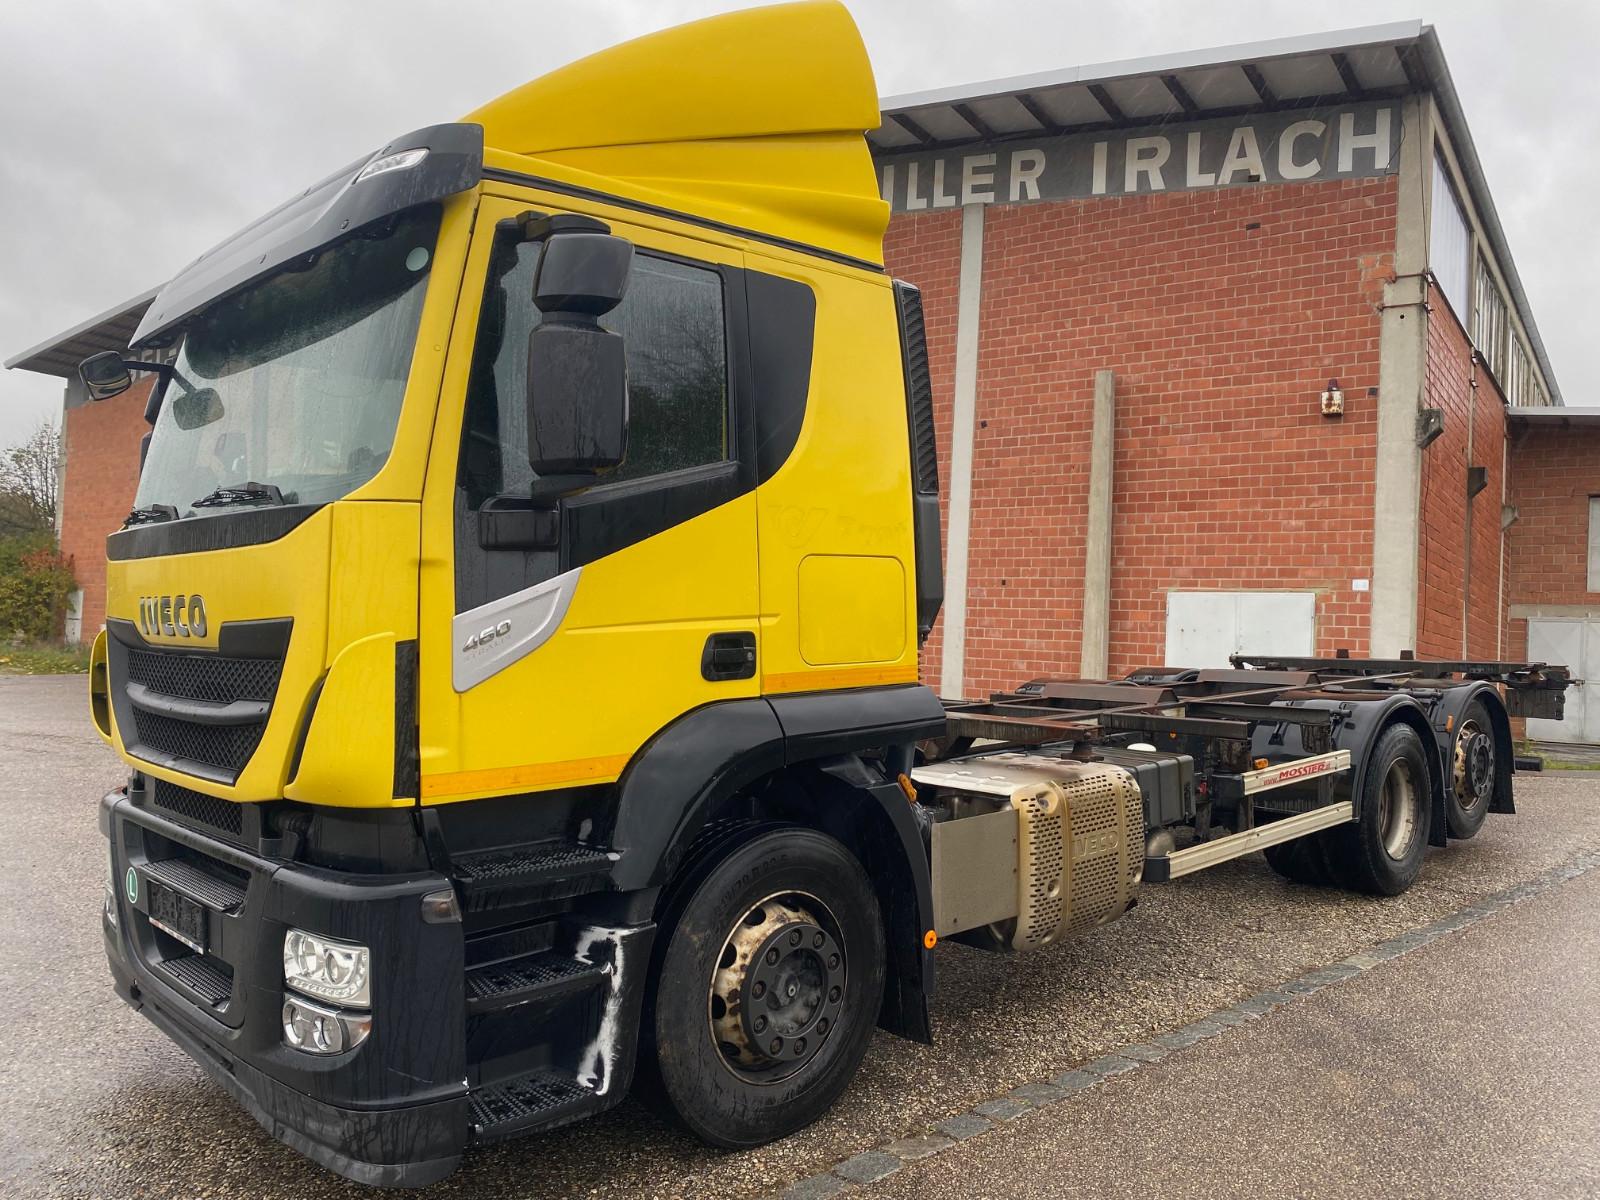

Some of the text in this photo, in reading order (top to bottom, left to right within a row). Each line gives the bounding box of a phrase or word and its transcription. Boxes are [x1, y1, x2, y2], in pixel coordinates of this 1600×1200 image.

[1091, 107, 1392, 195] IRLACH
[139, 594, 207, 638] IVECO
[462, 619, 511, 652] 460
[1071, 830, 1120, 860] IVECO
